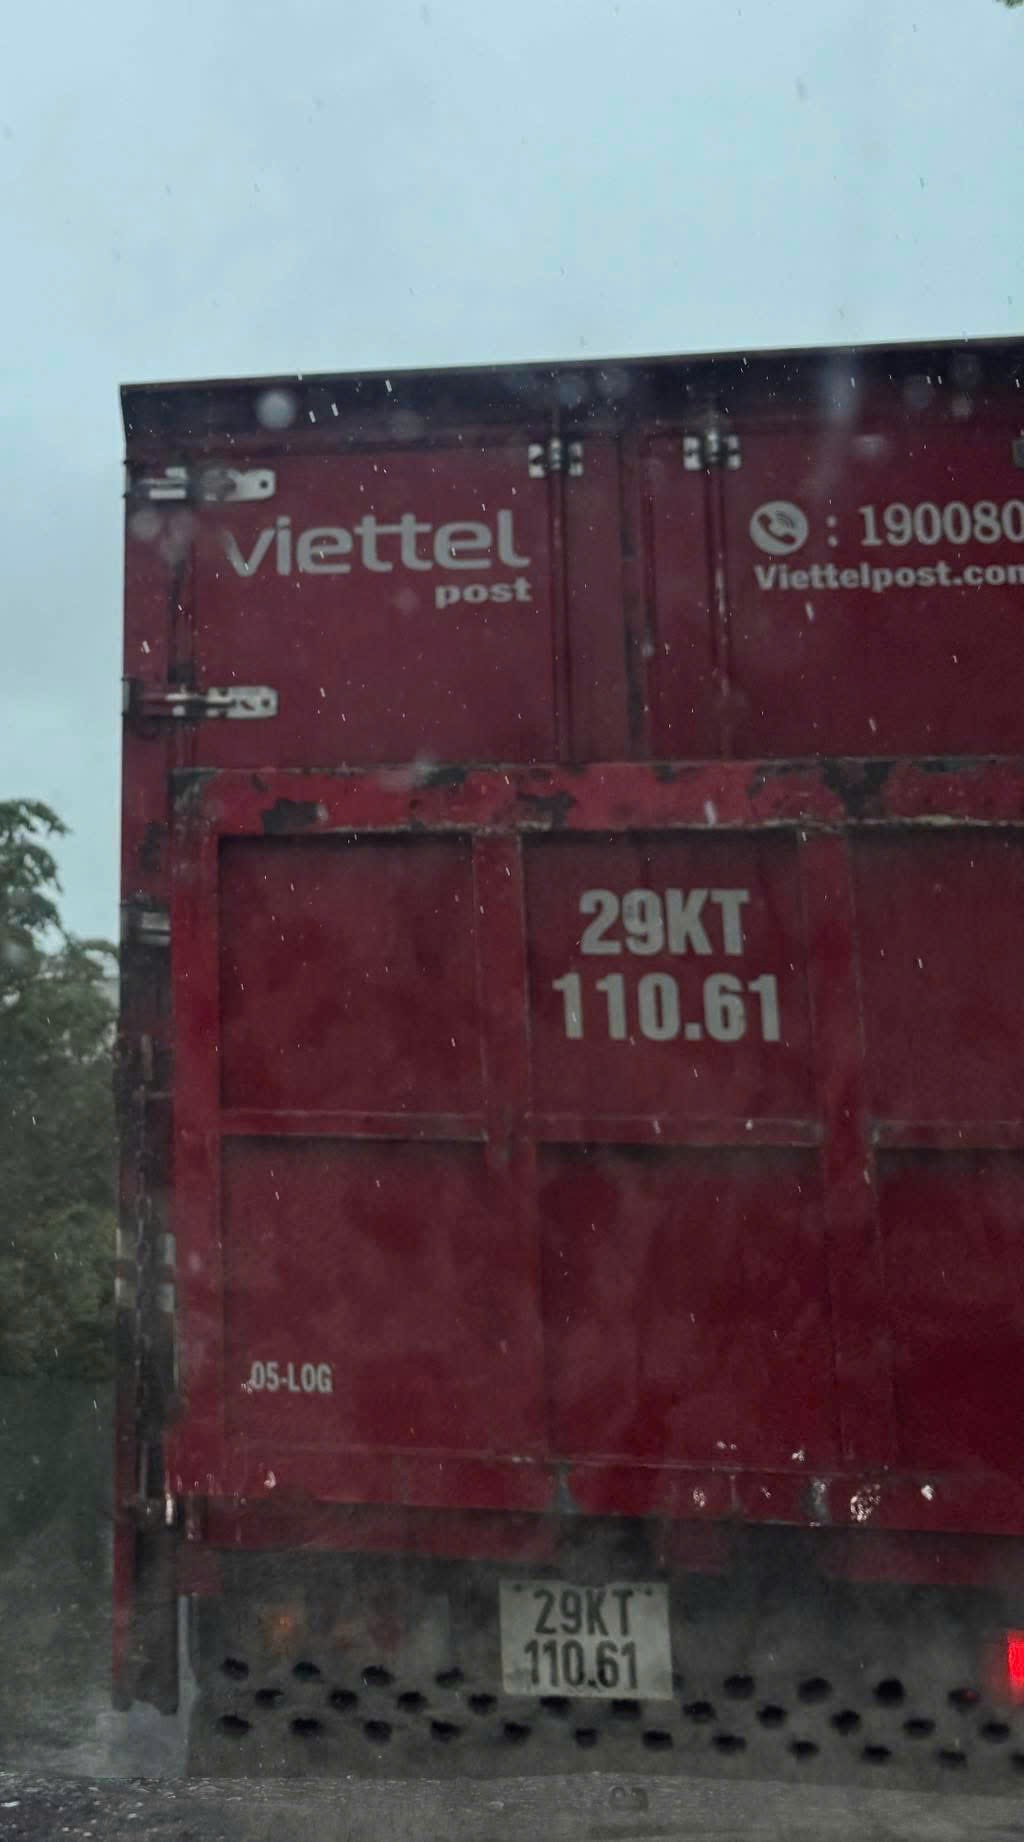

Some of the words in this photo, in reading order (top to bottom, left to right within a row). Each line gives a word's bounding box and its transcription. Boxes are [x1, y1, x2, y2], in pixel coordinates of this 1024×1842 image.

[225, 509, 531, 576] viettel
[435, 577, 532, 609] post
[579, 888, 750, 956] 29KT
[551, 972, 781, 1042] 110.61
[533, 1588, 635, 1637] 29KT
[524, 1639, 639, 1690] 110.61
